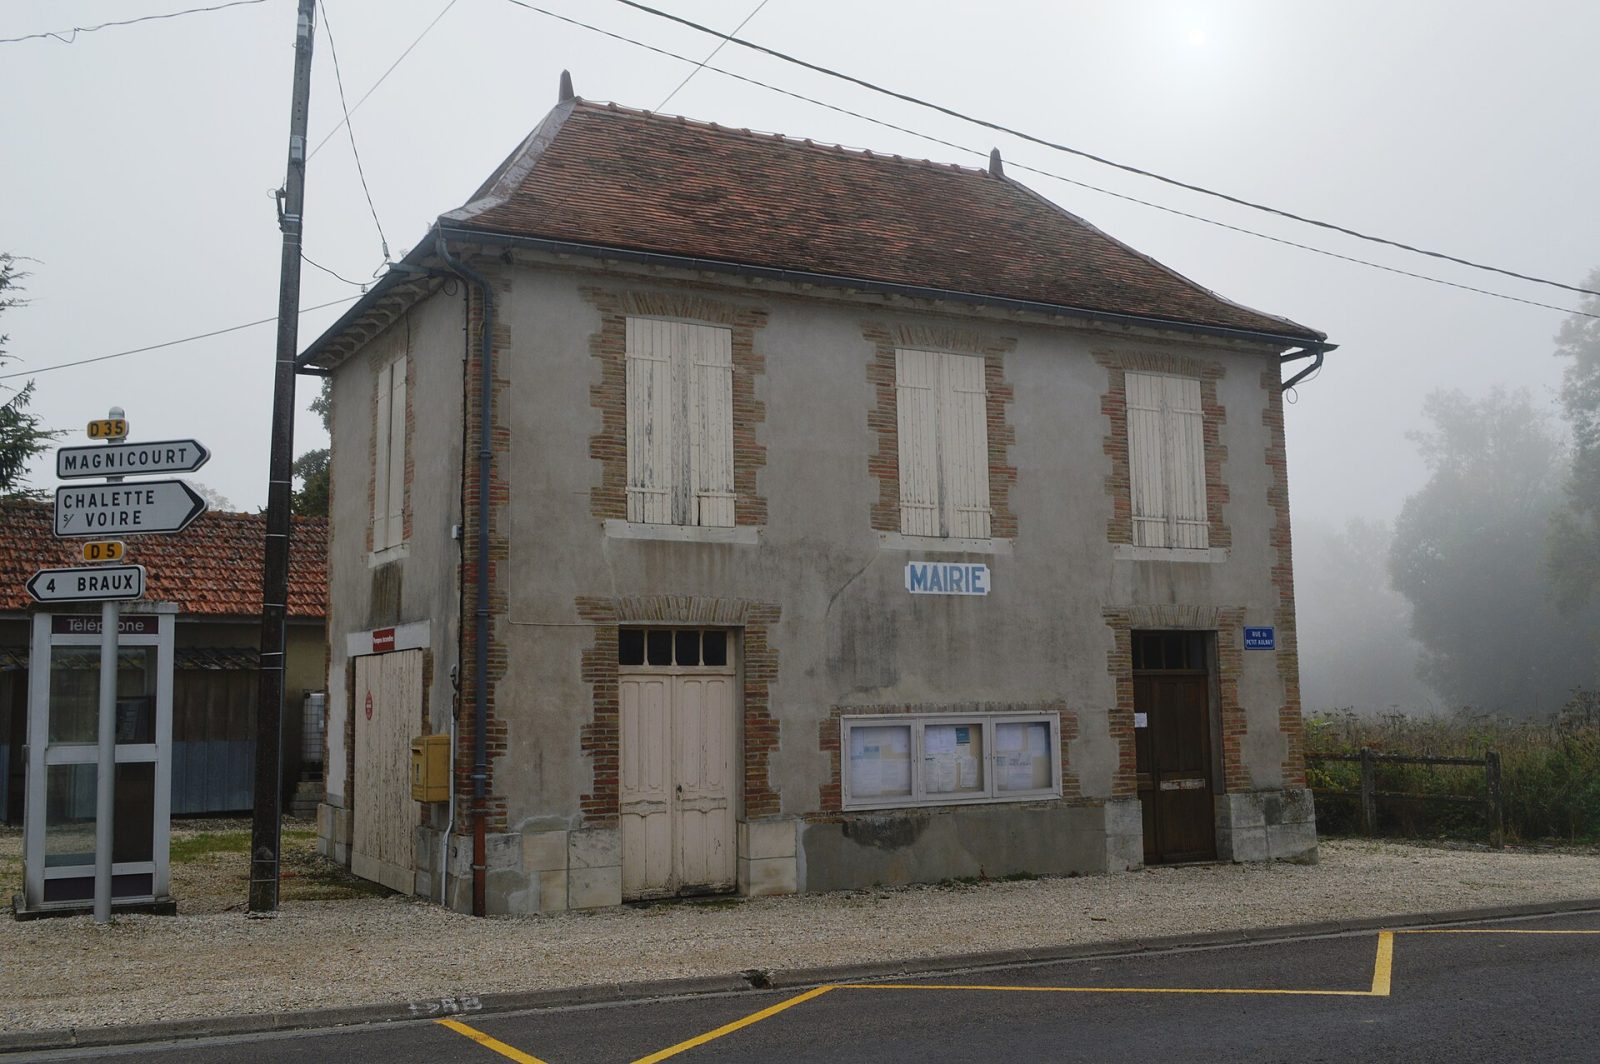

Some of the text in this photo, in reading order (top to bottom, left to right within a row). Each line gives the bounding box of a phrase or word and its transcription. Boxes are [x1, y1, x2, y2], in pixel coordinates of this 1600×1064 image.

[90, 421, 124, 437] D 35
[64, 448, 188, 471] MAGNICOURT
[63, 490, 155, 509] CHALETTE
[86, 510, 142, 527] VOIRE
[91, 543, 116, 559] D 5
[46, 575, 133, 593] 4 BRAUX
[909, 564, 985, 593] MAIRIE
[67, 617, 144, 635] Télépone
